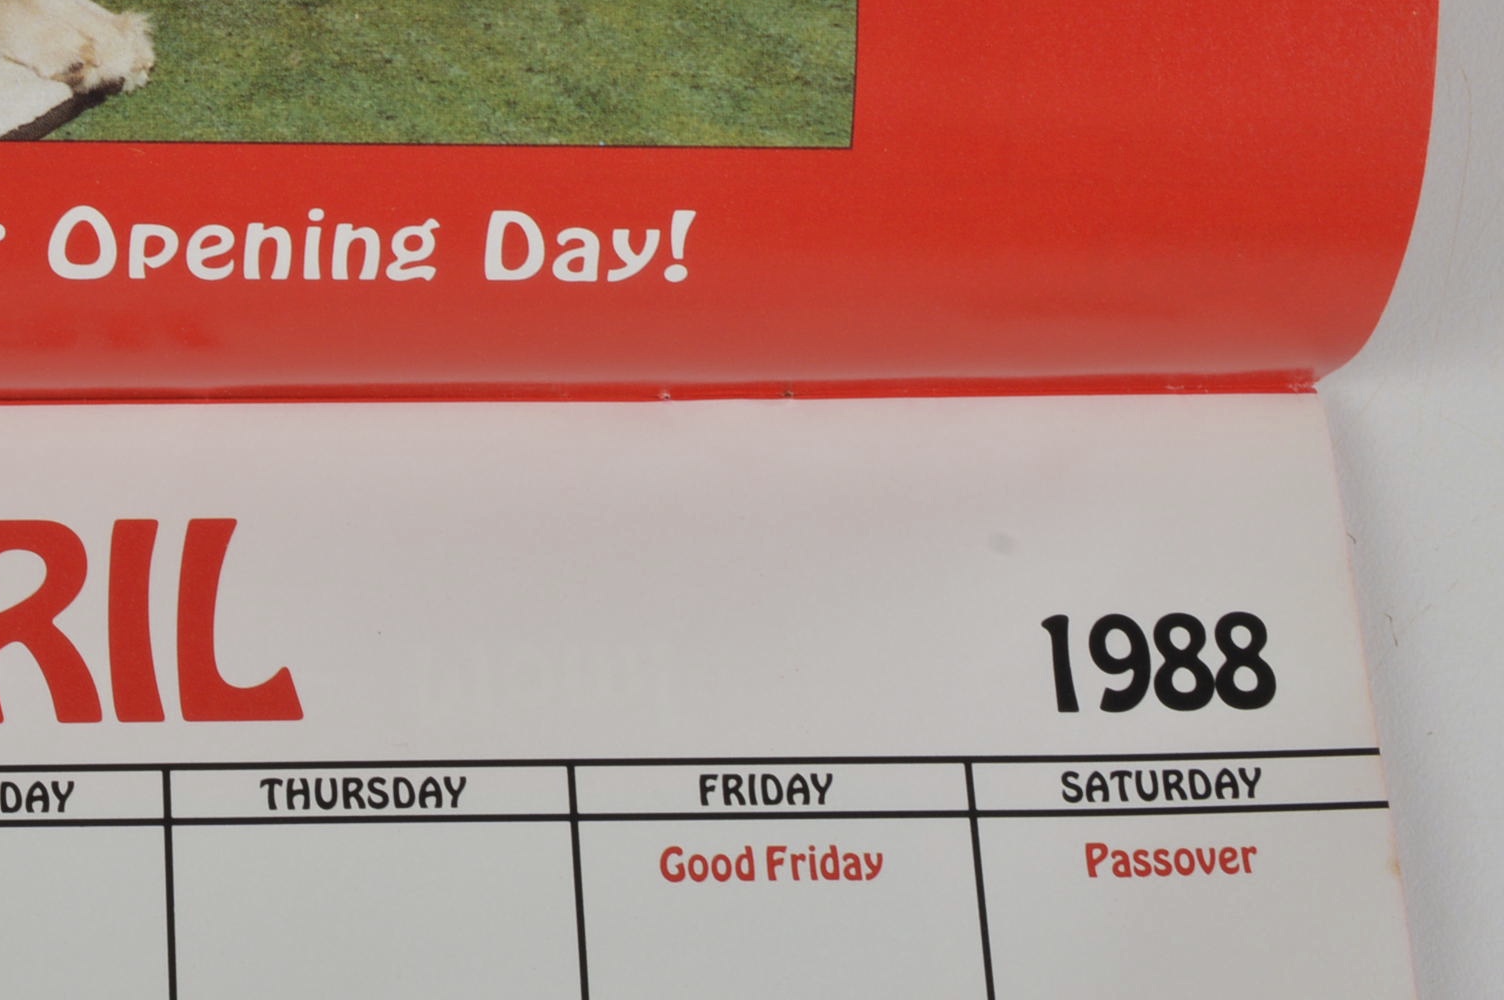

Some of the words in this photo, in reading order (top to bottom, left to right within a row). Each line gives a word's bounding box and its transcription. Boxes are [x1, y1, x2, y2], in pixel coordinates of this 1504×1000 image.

[47, 204, 441, 282] Opening
[483, 209, 697, 283] Day!
[1041, 611, 1277, 713] 1988
[259, 776, 467, 811] THURSDAY
[699, 773, 833, 806] FRIDAY
[1061, 767, 1262, 804] SATURDAY
[660, 845, 756, 883] Good
[766, 844, 884, 881] Friday
[1085, 842, 1258, 879] Passover
